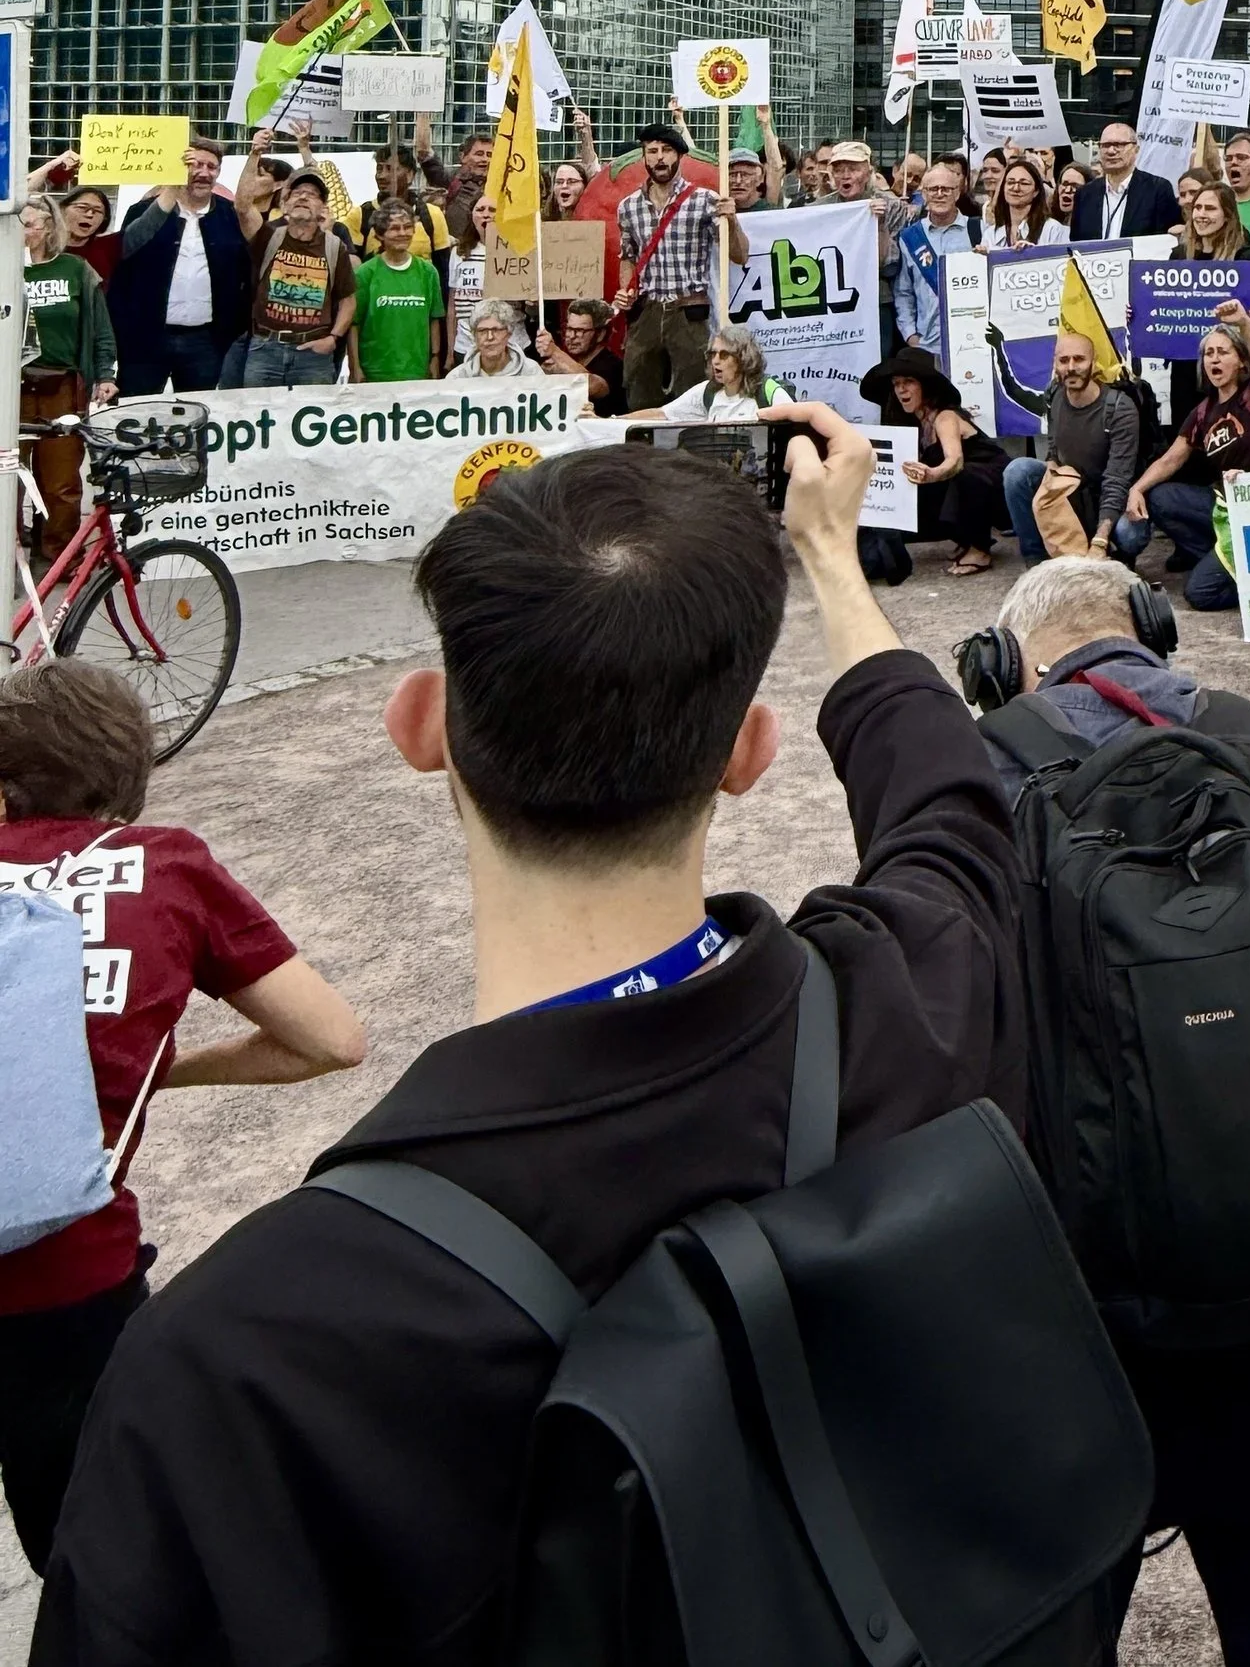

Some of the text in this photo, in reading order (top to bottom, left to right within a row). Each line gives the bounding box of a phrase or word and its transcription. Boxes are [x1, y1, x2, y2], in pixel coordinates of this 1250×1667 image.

[129, 127, 158, 138] risk
[494, 257, 530, 275] WER
[952, 275, 979, 287] SOS
[999, 269, 1055, 292] Keep
[1141, 269, 1239, 289] +600,000
[24, 279, 69, 298] CKERN
[1159, 307, 1184, 320] Keep
[1186, 308, 1203, 318] the
[1154, 323, 1173, 335] Say
[1175, 324, 1188, 333] no
[1189, 324, 1199, 333] to
[783, 371, 797, 380] to
[801, 367, 823, 379] the
[116, 393, 567, 463] Stoppt Gentechnik!
[161, 499, 390, 532] eine gentechnikfreie
[298, 526, 316, 543] in
[325, 523, 415, 540] Sachsen
[1185, 1009, 1234, 1025] QUECHUA
